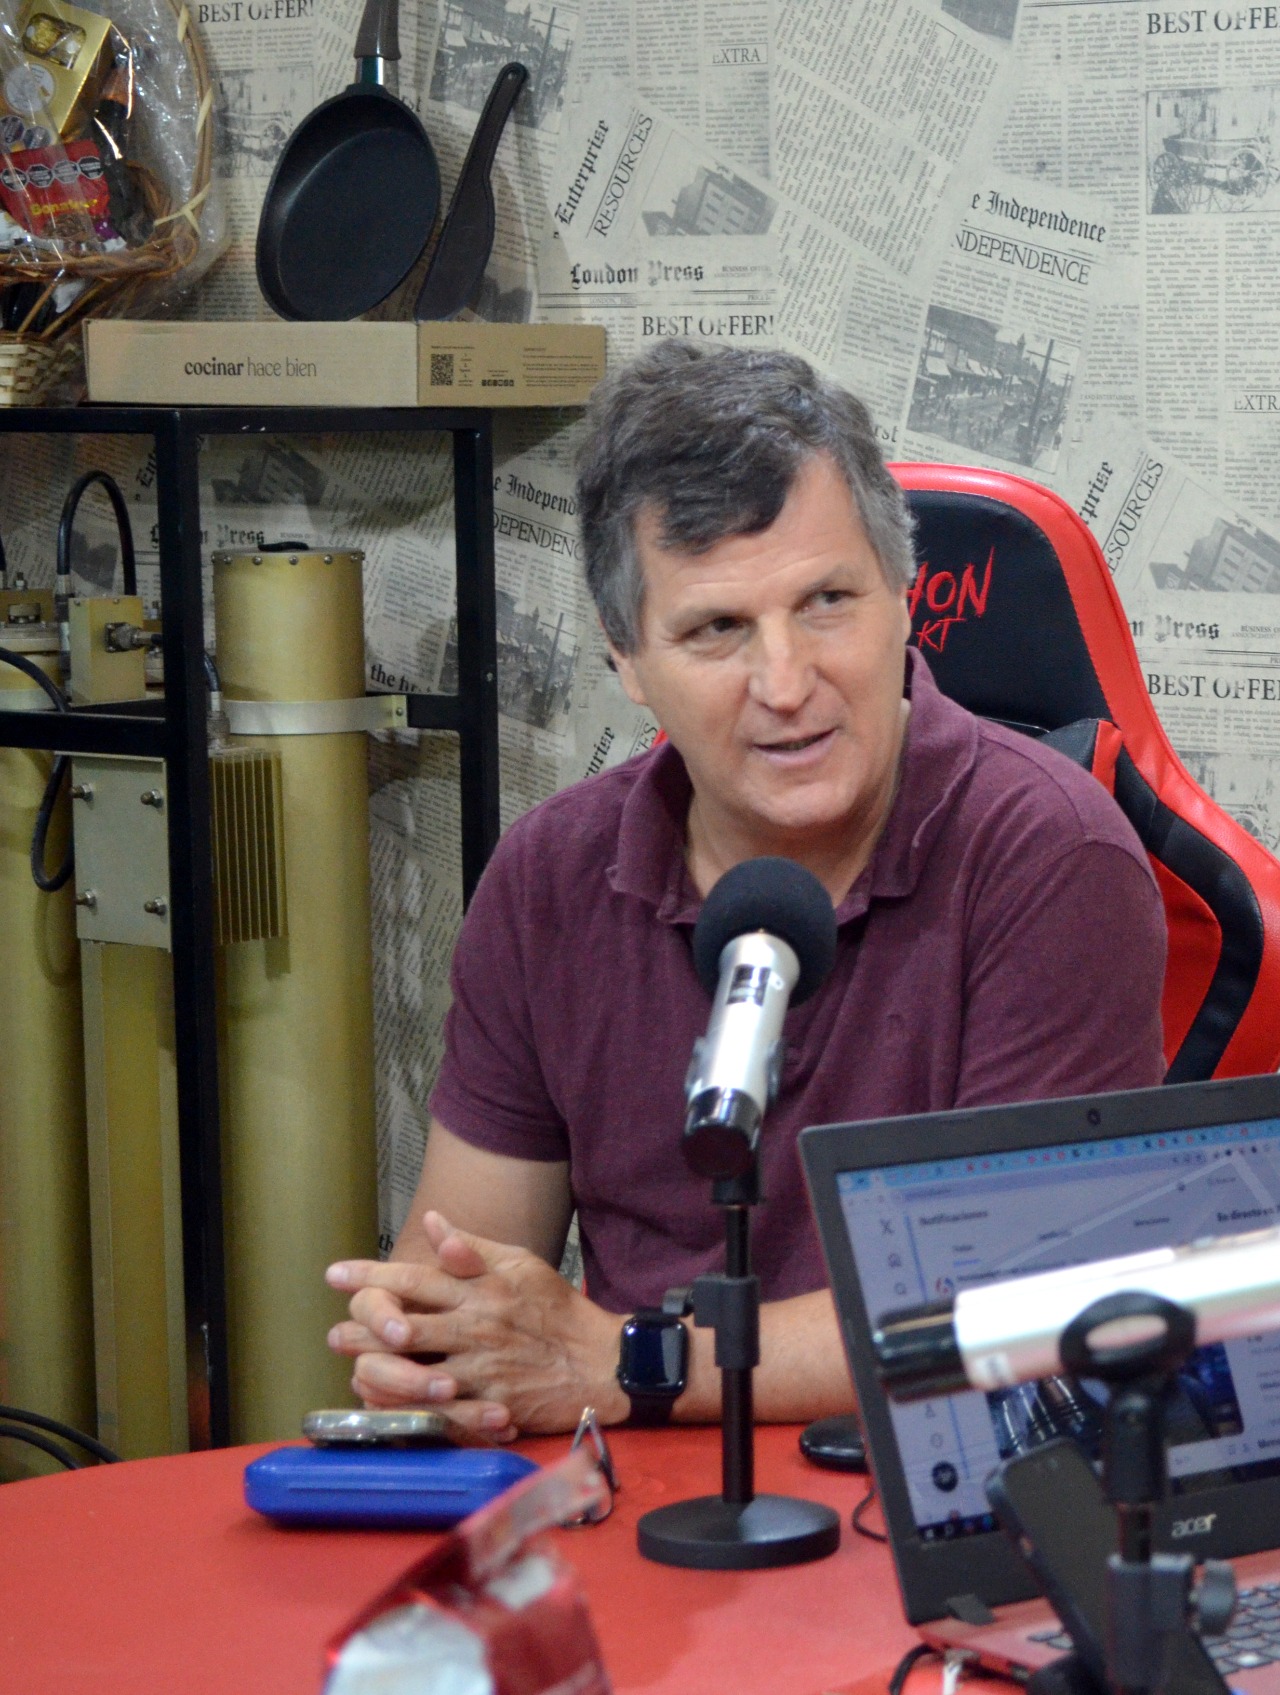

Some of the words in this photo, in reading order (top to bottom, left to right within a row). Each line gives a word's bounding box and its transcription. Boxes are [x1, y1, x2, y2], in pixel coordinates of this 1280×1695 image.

[199, 1, 247, 23] BEST
[1147, 10, 1206, 34] BEST
[555, 119, 609, 226] Enterprise
[594, 114, 653, 238] RESOURCES
[985, 190, 1106, 242] Independence
[954, 229, 1091, 285] NDEPENDENCE
[570, 263, 638, 290] London
[642, 315, 693, 336] BEST
[185, 359, 244, 377] cocinar
[247, 358, 282, 377] hace
[286, 357, 318, 377] bien
[1106, 458, 1164, 575] ESOURCES
[370, 662, 396, 684] the
[1147, 674, 1206, 697] BEST
[1171, 1513, 1217, 1539] acer
